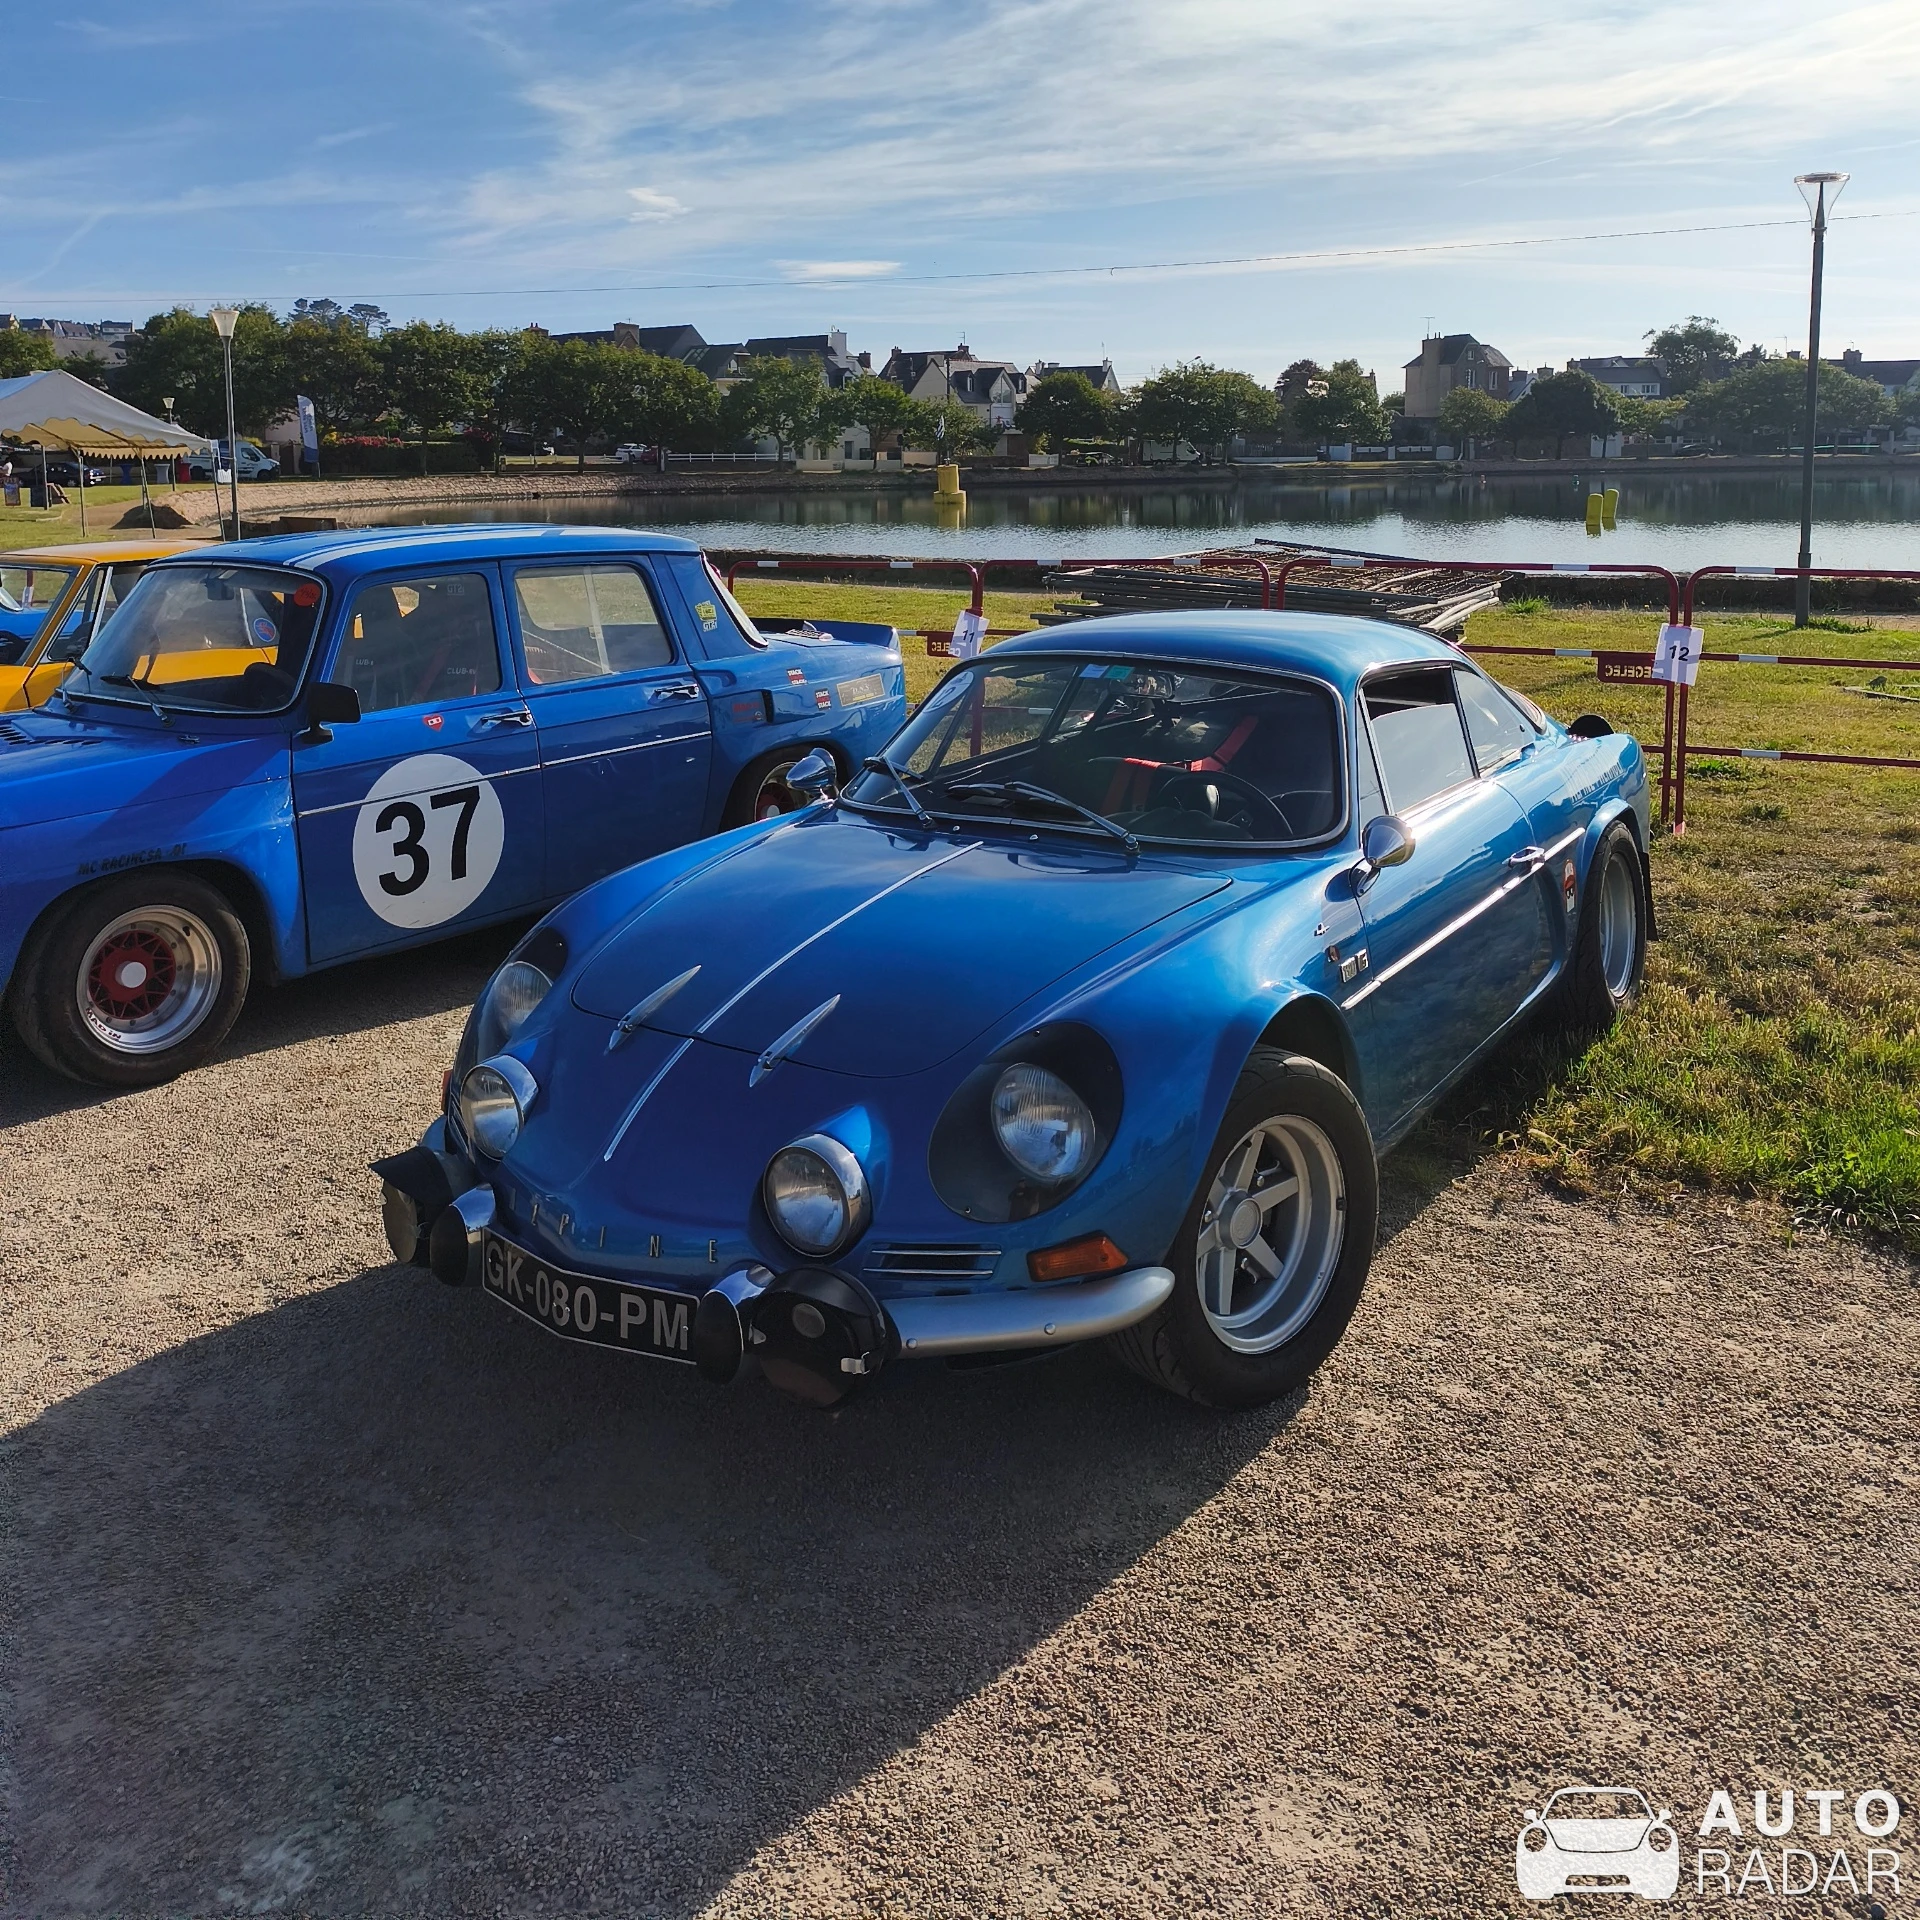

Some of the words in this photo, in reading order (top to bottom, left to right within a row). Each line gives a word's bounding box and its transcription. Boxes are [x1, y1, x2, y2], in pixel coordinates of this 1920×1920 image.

[962, 629, 975, 643] 11
[1669, 645, 1690, 661] 12
[375, 785, 481, 896] 37
[486, 1240, 689, 1350] GK-080-PM
